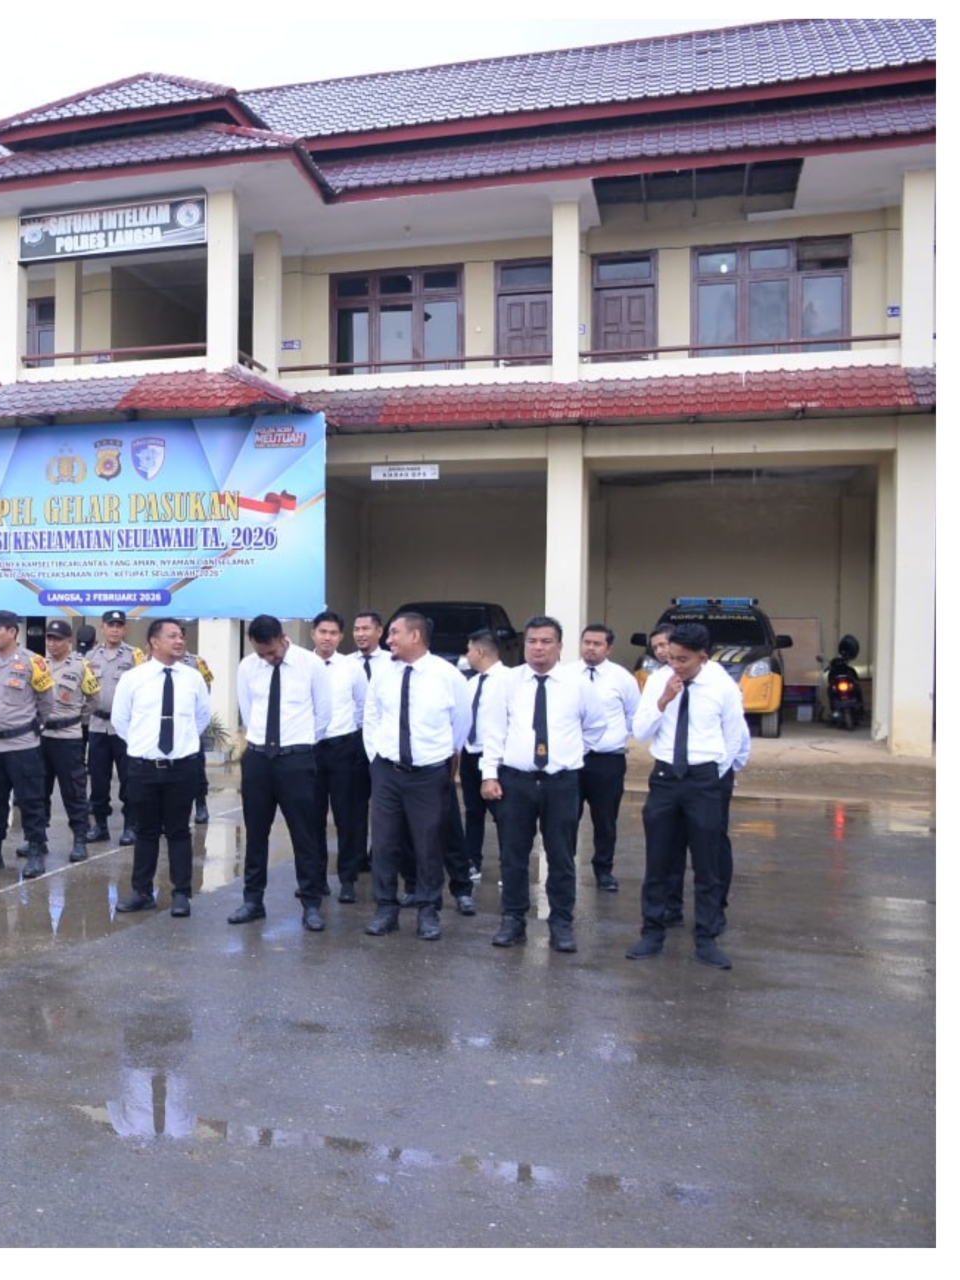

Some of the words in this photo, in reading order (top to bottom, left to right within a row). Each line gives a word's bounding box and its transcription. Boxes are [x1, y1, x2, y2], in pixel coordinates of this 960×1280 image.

[48, 211, 100, 236] SATUAN
[102, 204, 171, 231] INTELKAM
[55, 234, 106, 253] POLRES
[108, 227, 162, 249] LANGSA
[43, 494, 120, 526] GELAR
[128, 490, 239, 523] PASUKAN
[12, 528, 112, 551] KESELAMATAN
[117, 526, 196, 550] SEULAWAH
[201, 526, 226, 548] TA.
[231, 526, 276, 548] 2026
[46, 593, 83, 603] LANGSA,
[85, 593, 92, 602] 2
[93, 593, 137, 602] FEBRUARI
[139, 593, 161, 602] 2026
